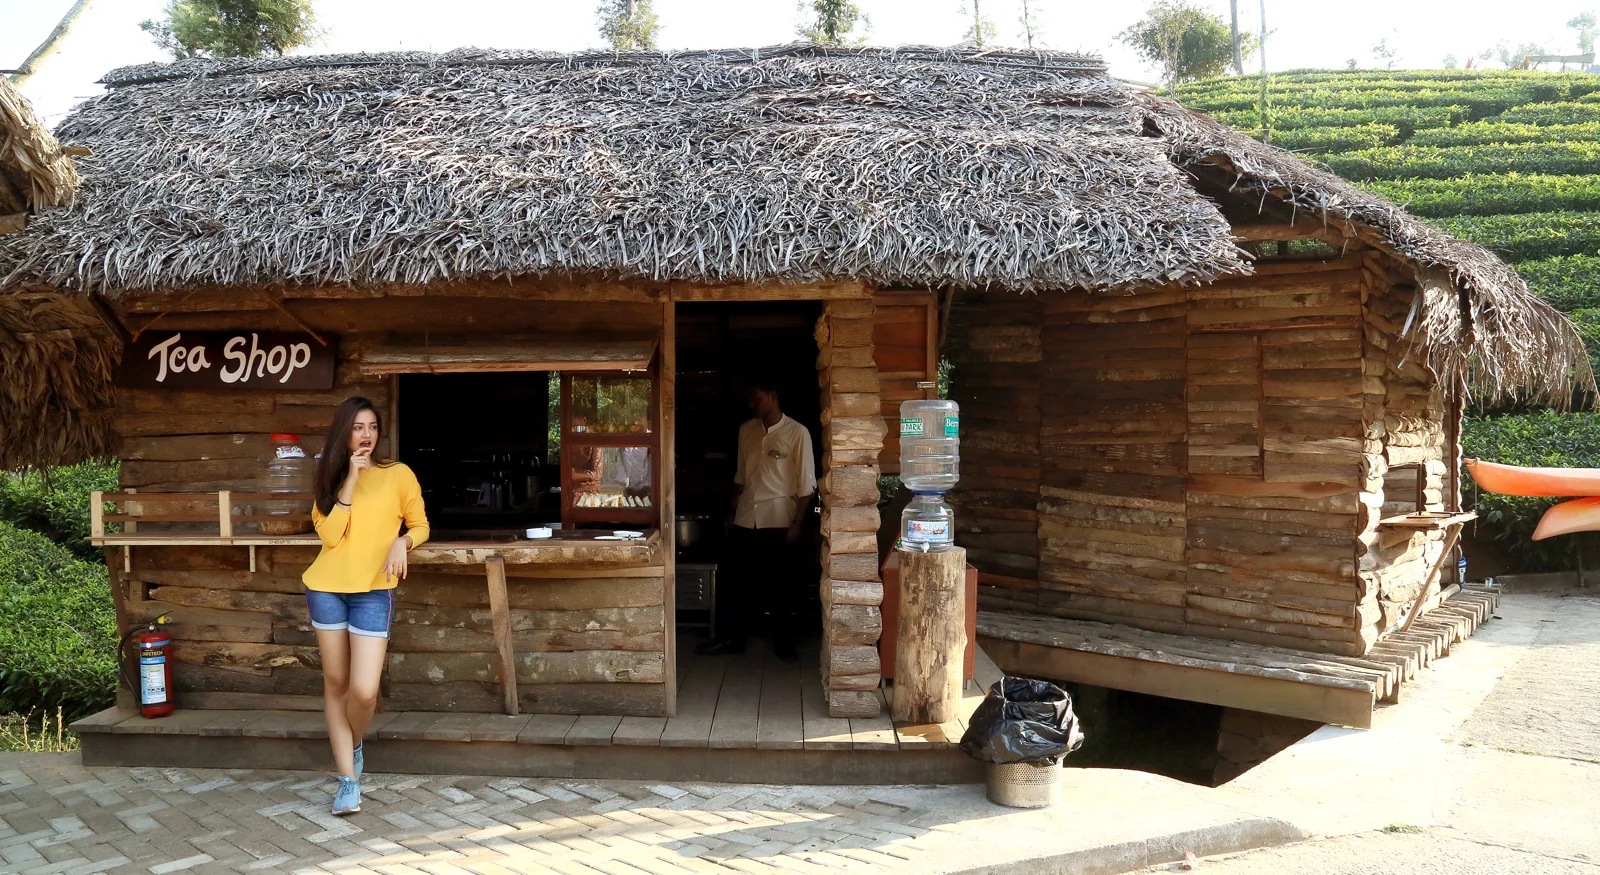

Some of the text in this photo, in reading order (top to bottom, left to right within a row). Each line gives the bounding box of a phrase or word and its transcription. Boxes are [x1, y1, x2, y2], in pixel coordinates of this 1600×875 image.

[147, 332, 311, 383] Tea Shop
[905, 423, 922, 431] PARK
